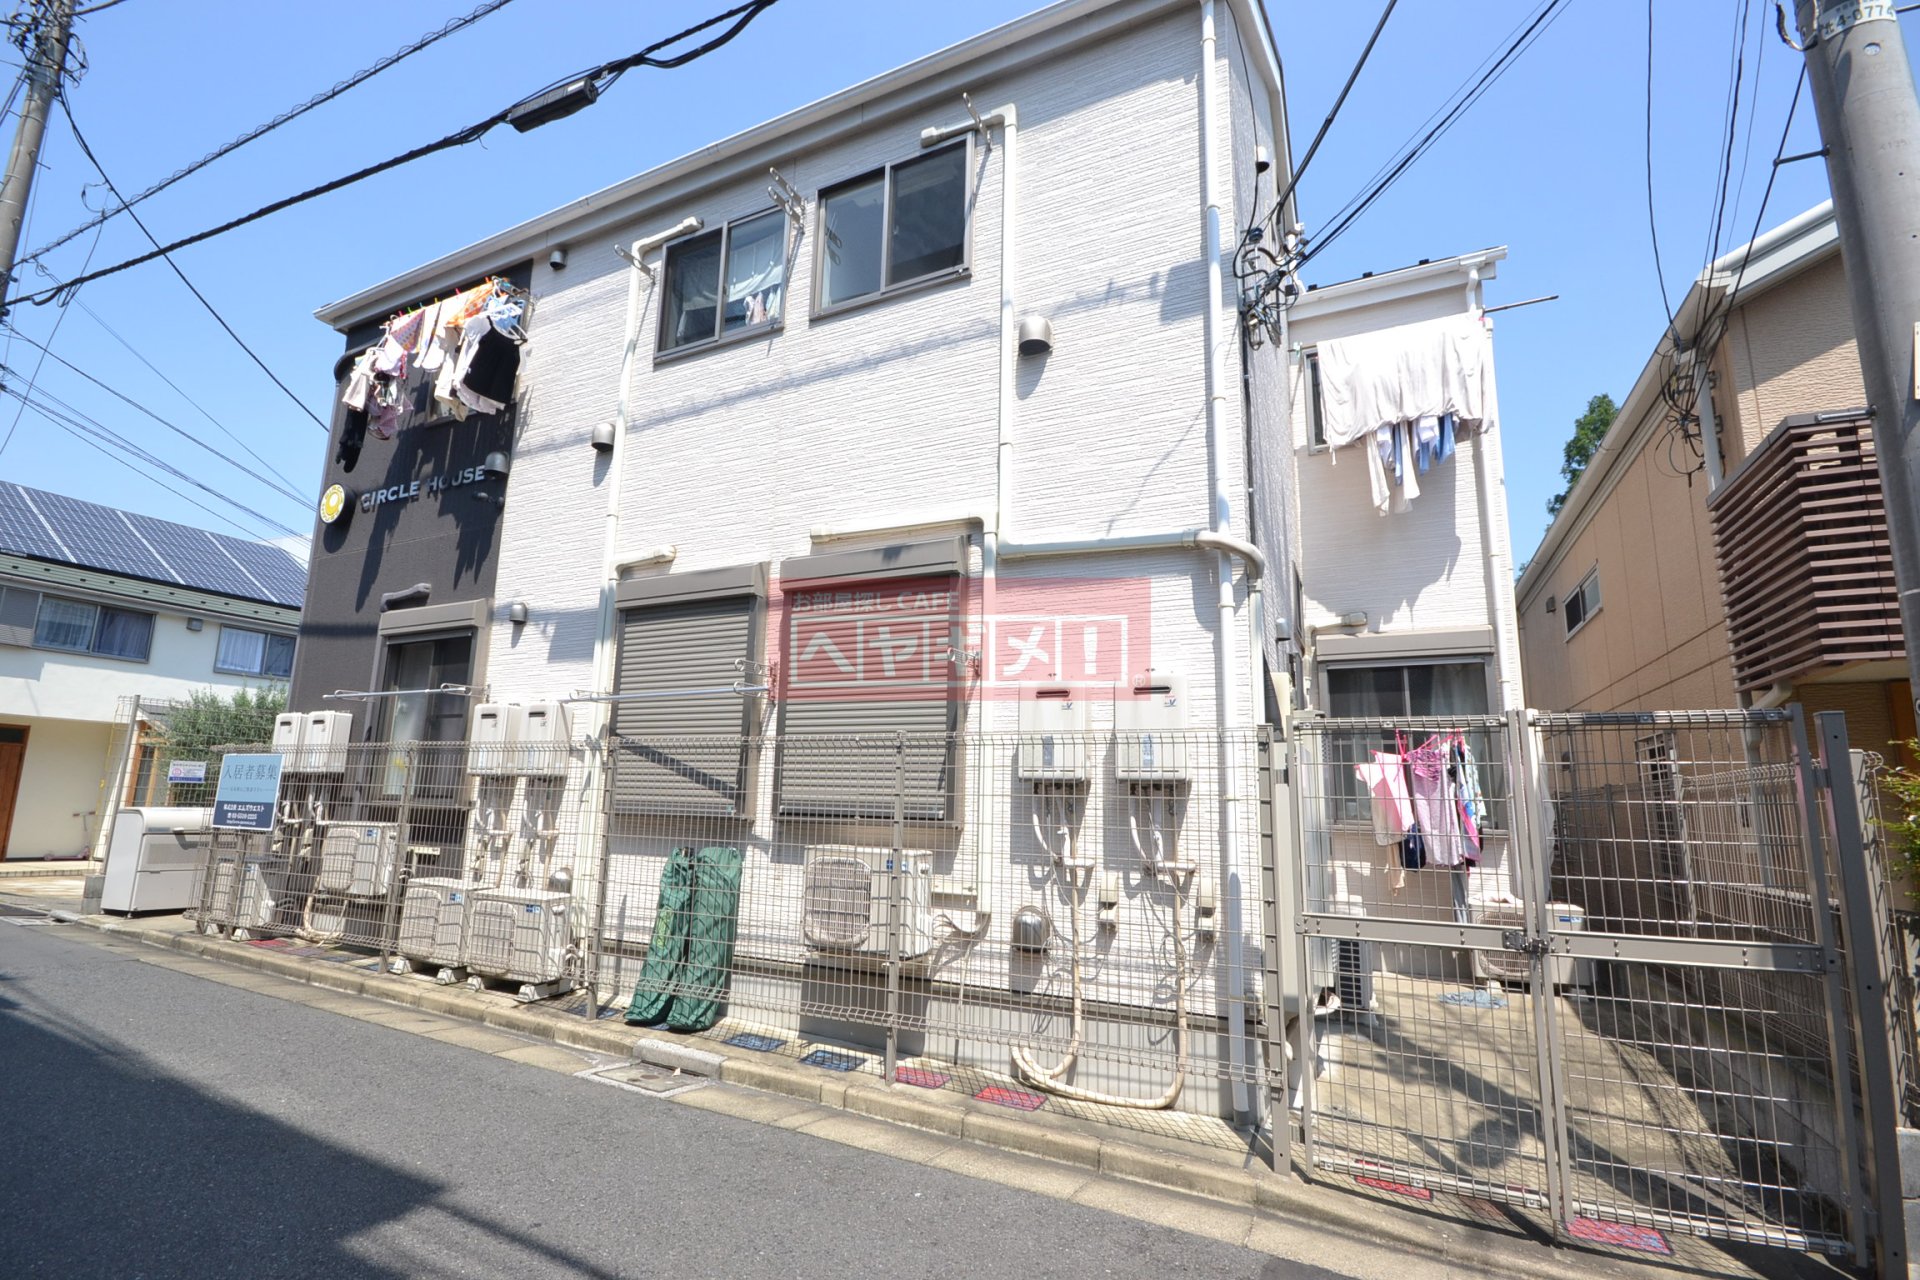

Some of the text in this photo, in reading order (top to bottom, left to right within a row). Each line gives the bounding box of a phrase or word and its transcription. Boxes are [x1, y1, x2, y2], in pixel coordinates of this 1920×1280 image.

[361, 480, 421, 507] CIRCLE
[426, 464, 486, 492] HOUSE
[222, 763, 278, 781] 入居者募集
